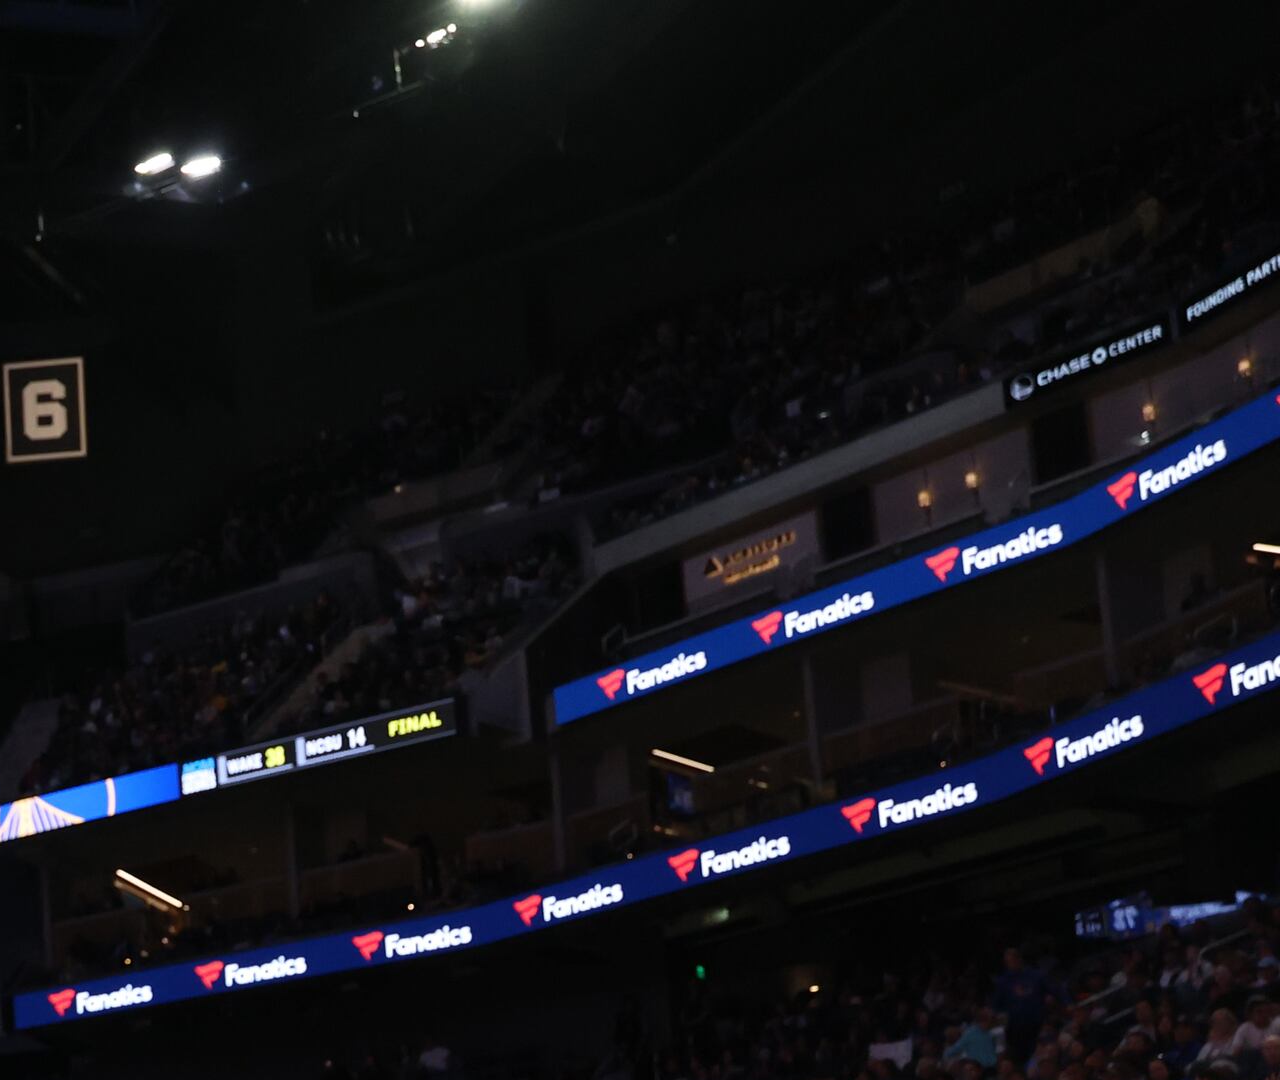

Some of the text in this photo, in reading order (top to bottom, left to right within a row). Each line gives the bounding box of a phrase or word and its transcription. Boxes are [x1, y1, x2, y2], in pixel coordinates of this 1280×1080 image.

[1187, 277, 1245, 322] FOUNDING
[1037, 325, 1162, 387] CHASE CENTER
[22, 379, 68, 441] 6
[1138, 438, 1227, 499] Fanatics
[961, 521, 1062, 574] Fanatics
[784, 590, 874, 637] Fanatics
[626, 649, 706, 695] Fanatics
[346, 726, 367, 749] 14
[388, 711, 441, 737] FINAL
[1055, 714, 1144, 767] Fanatics
[878, 781, 977, 827] Fanatics
[701, 833, 790, 876] Fanatics
[542, 881, 623, 921] Fanatics
[384, 924, 471, 957] Fanatics
[225, 954, 306, 986] Fanatics
[76, 982, 152, 1015] Fanatics
